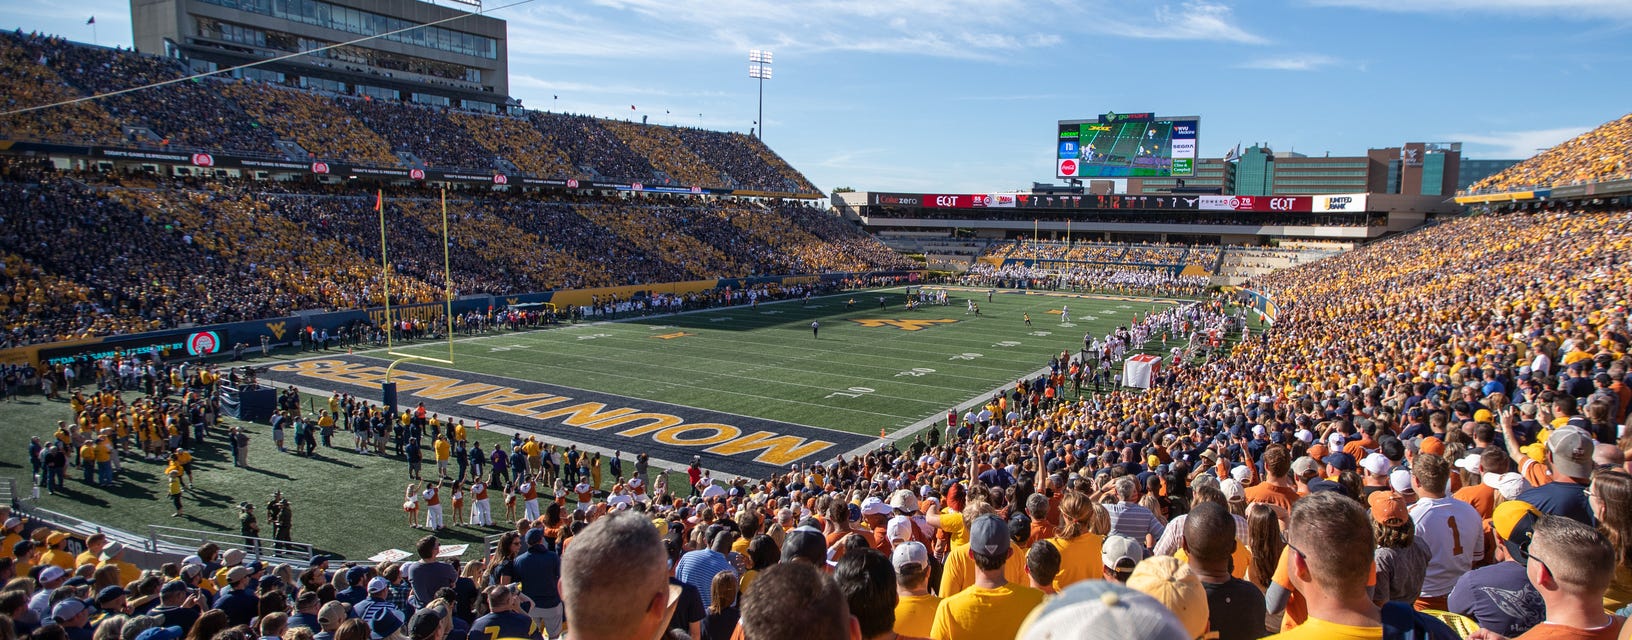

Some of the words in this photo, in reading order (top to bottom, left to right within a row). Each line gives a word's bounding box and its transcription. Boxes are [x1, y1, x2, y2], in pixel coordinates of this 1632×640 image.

[936, 195, 959, 207] EQT
[1033, 196, 1039, 206] 7
[1172, 197, 1177, 208] 7
[1270, 198, 1296, 211] EQT
[1447, 515, 1464, 556] 1
